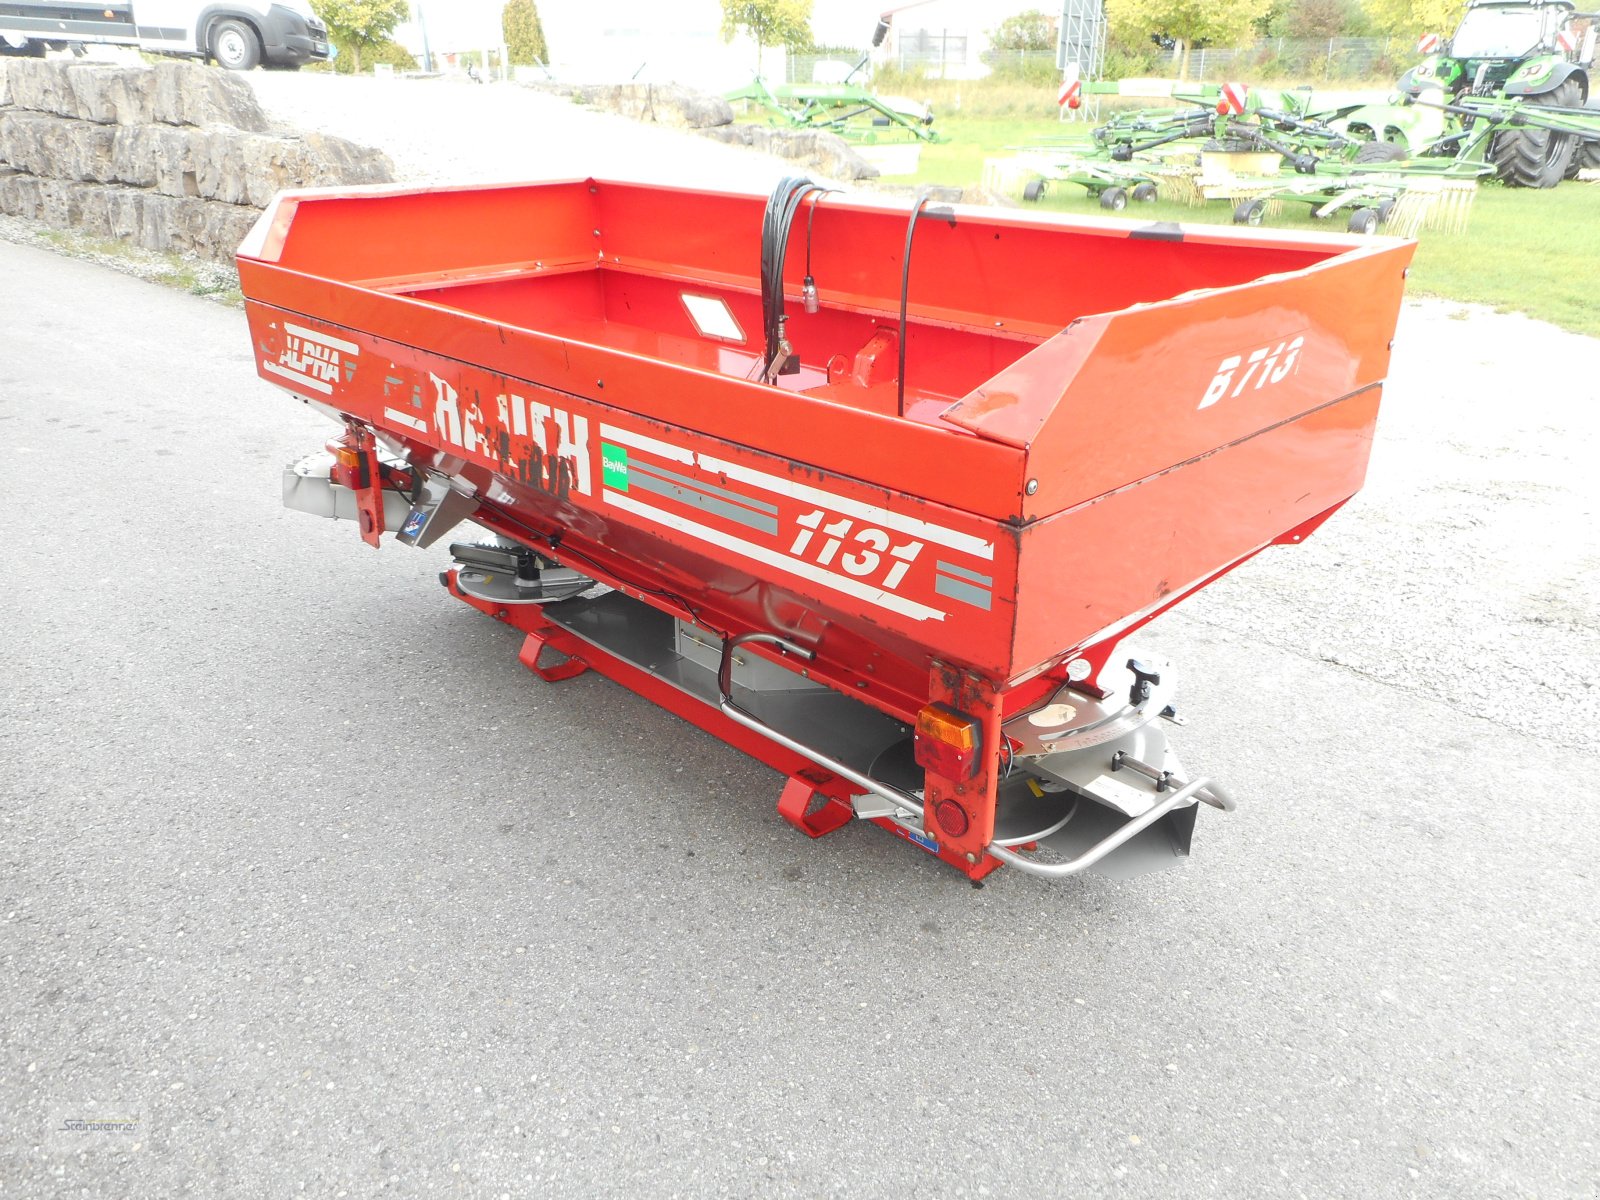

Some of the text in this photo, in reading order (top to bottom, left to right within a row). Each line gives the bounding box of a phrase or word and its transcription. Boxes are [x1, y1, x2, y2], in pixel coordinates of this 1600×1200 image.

[279, 335, 340, 383] ALPHA
[1230, 336, 1304, 398] 713
[603, 456, 628, 475] BayWa
[789, 509, 924, 590] 1131
